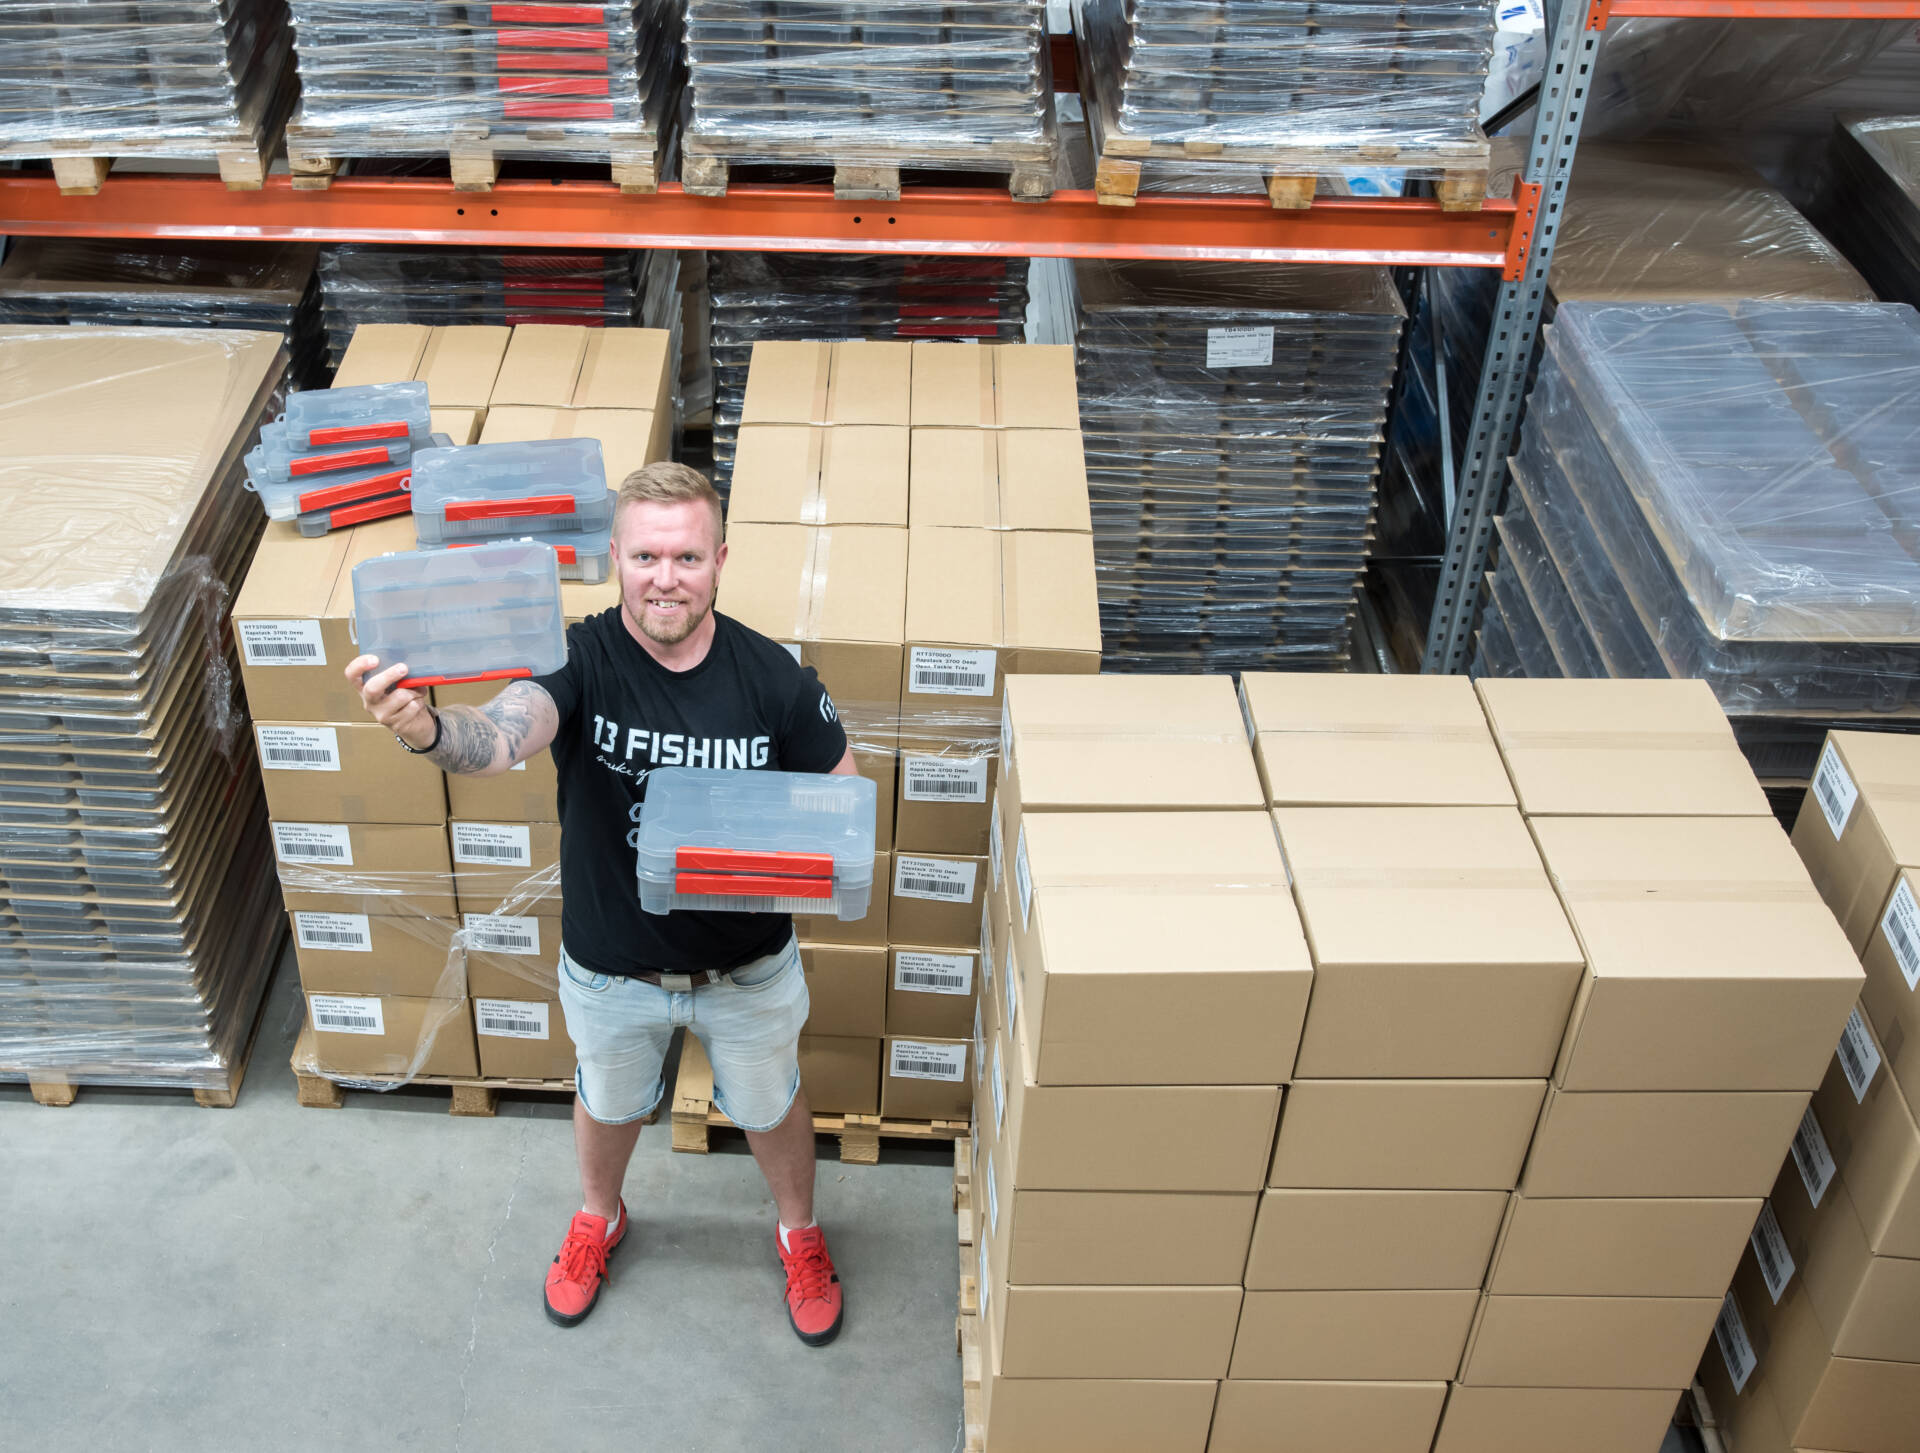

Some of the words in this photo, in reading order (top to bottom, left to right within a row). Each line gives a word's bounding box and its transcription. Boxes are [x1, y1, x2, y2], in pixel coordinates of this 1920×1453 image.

[594, 714, 619, 753] 13
[625, 727, 770, 770] FISHING
[596, 754, 634, 776] make
